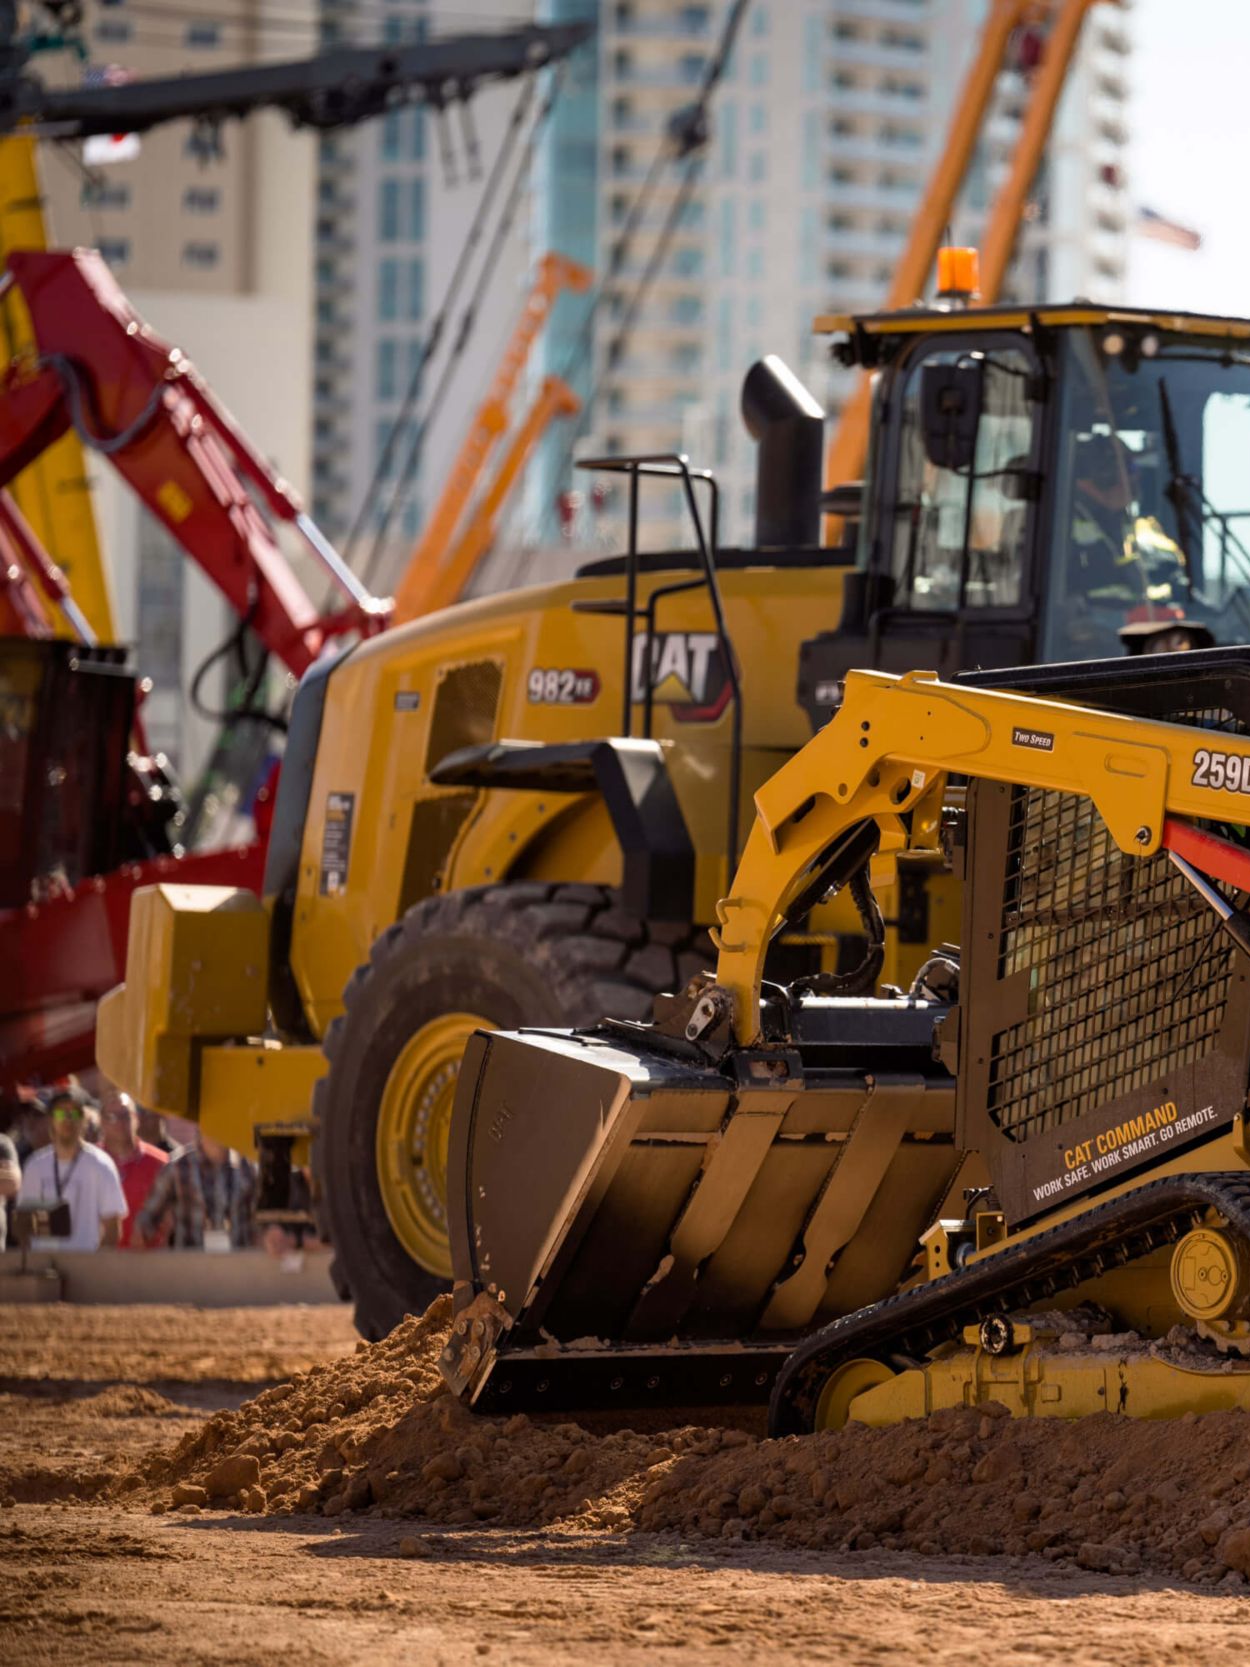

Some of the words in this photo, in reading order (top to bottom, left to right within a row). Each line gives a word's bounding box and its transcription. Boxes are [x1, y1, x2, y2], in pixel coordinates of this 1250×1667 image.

[630, 632, 718, 704] CAT
[1033, 1177, 1063, 1201] WORK
[1064, 1164, 1091, 1187] SAFE.
[1091, 1150, 1122, 1174] WORK
[1123, 1135, 1159, 1160] SMART.
[1160, 1126, 1174, 1142] GO
[1175, 1105, 1218, 1134] REMOTE.
[1096, 1101, 1178, 1154] COMMAND
